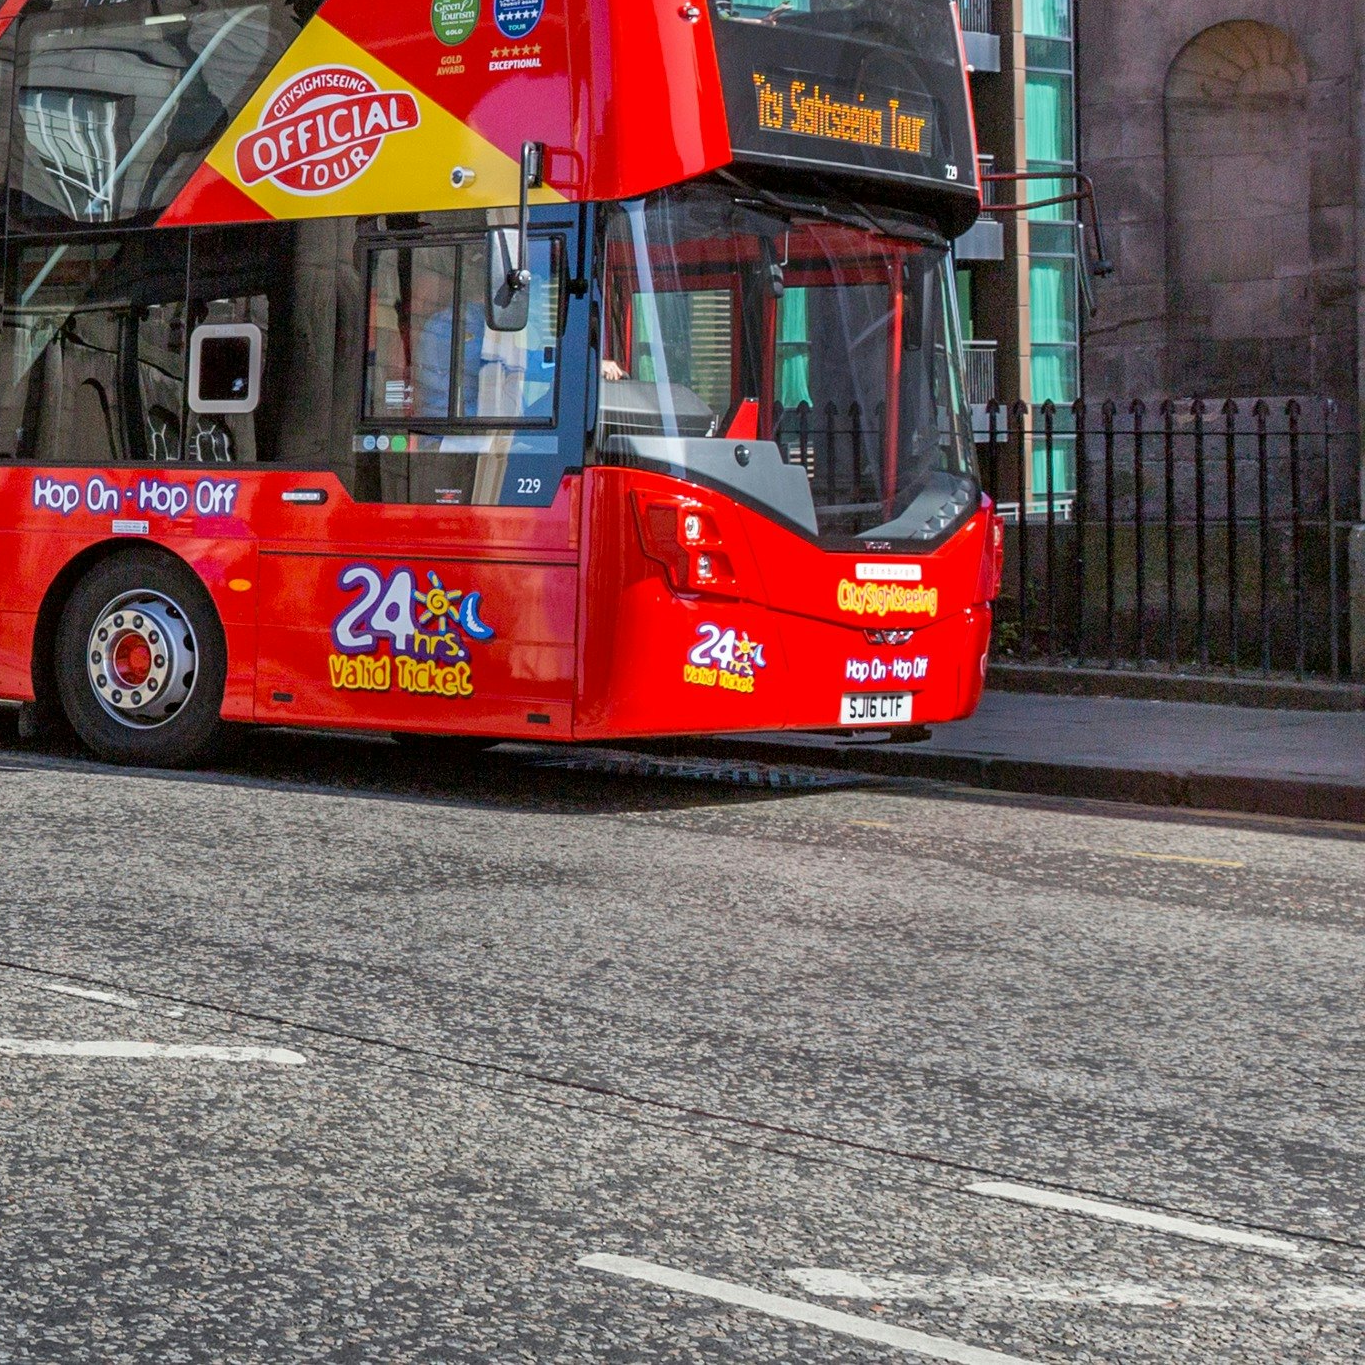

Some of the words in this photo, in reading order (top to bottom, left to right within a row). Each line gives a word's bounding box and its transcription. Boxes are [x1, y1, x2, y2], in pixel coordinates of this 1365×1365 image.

[434, 2, 460, 12] Green
[441, 10, 474, 21] Tourism
[445, 28, 463, 36] GOLD
[436, 65, 465, 76] AWARD
[441, 55, 462, 65] GOLD
[489, 58, 541, 71] EXCEPTIONAL
[273, 73, 368, 118] CITYSIGHTSEEING
[253, 98, 408, 171] OFFICIAL
[888, 99, 926, 153] Tour
[301, 146, 370, 185] TOUR
[33, 479, 80, 513] Hop
[87, 478, 118, 511] On
[139, 481, 188, 516] Hop
[196, 480, 237, 514] Off
[517, 478, 541, 494] 229
[334, 565, 416, 651] 24
[837, 579, 938, 617] CitySightseeing
[689, 623, 736, 669] 24
[329, 654, 390, 690] Valid
[395, 655, 473, 695] Ticket
[684, 664, 717, 687] Valid
[846, 659, 869, 682] Hop
[871, 658, 886, 680] On
[893, 658, 912, 680] Hop
[913, 656, 928, 678] Off
[849, 695, 877, 719] SJ16
[880, 695, 904, 718] CTF
